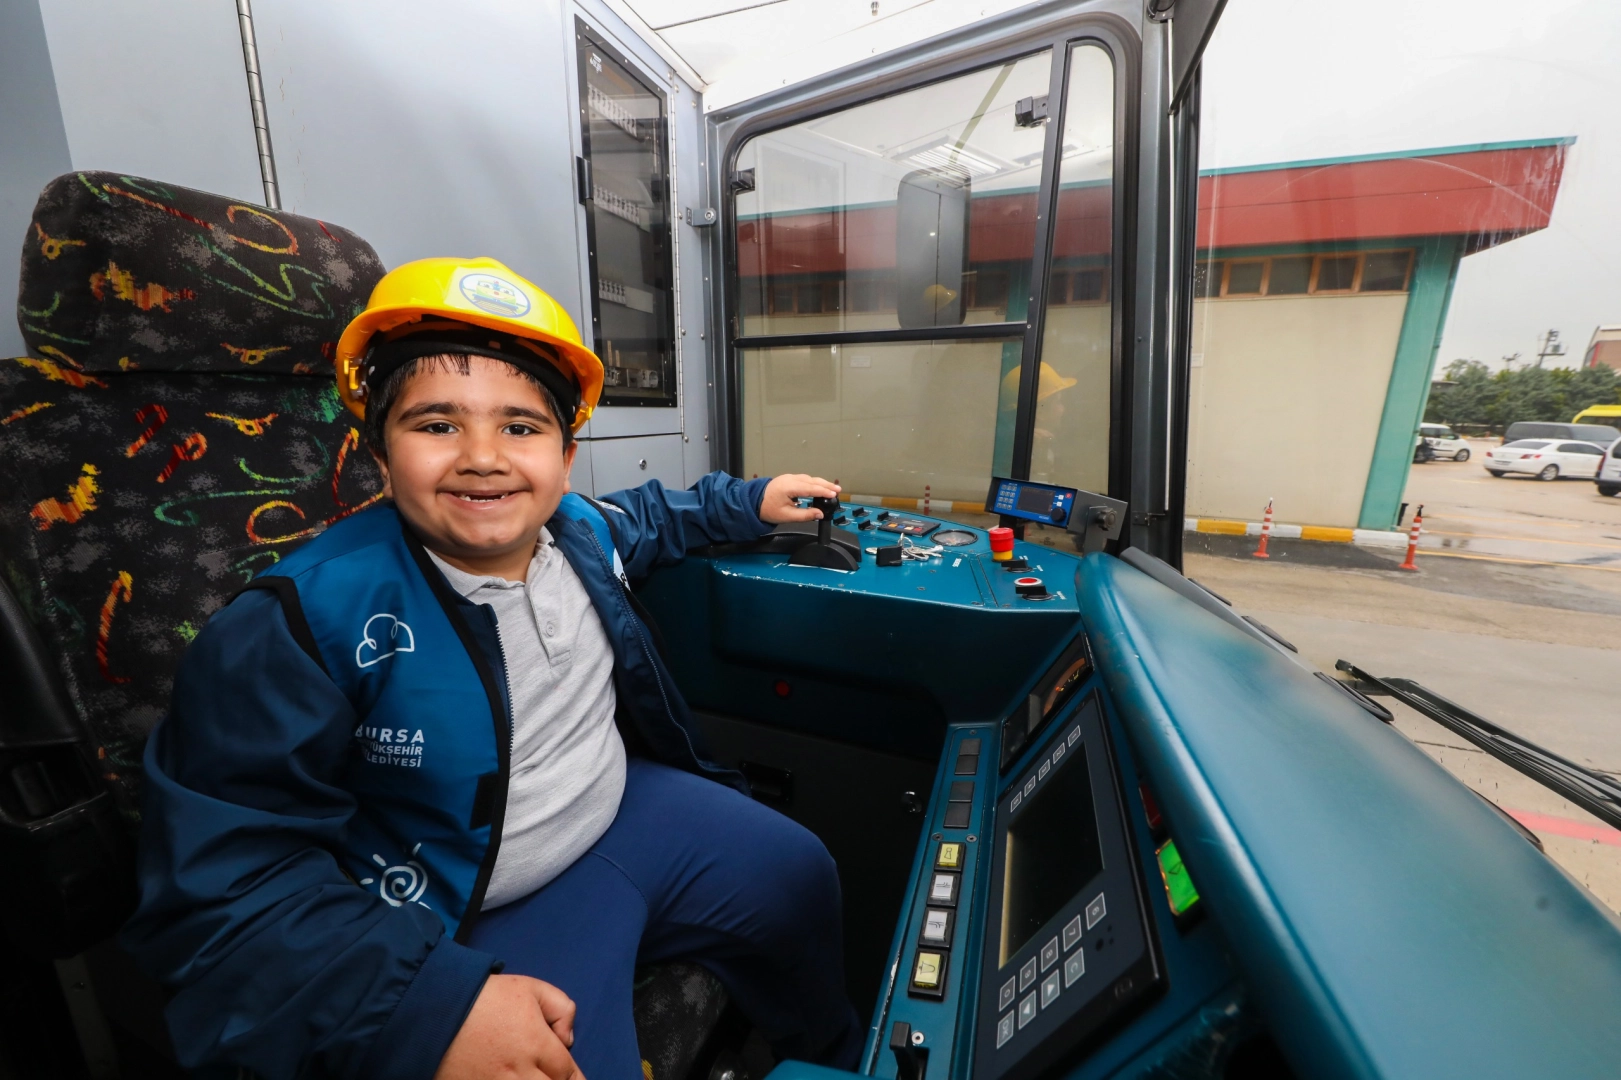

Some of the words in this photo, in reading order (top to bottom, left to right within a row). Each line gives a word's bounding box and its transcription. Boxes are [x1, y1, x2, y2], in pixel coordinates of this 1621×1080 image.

[354, 724, 425, 743] BURSA
[1092, 906, 1100, 916] 6
[1068, 927, 1076, 936] 7
[1045, 949, 1054, 959] 8
[1070, 962, 1078, 974] C
[1024, 969, 1032, 979] 9
[1002, 1019, 1010, 1039] OK
